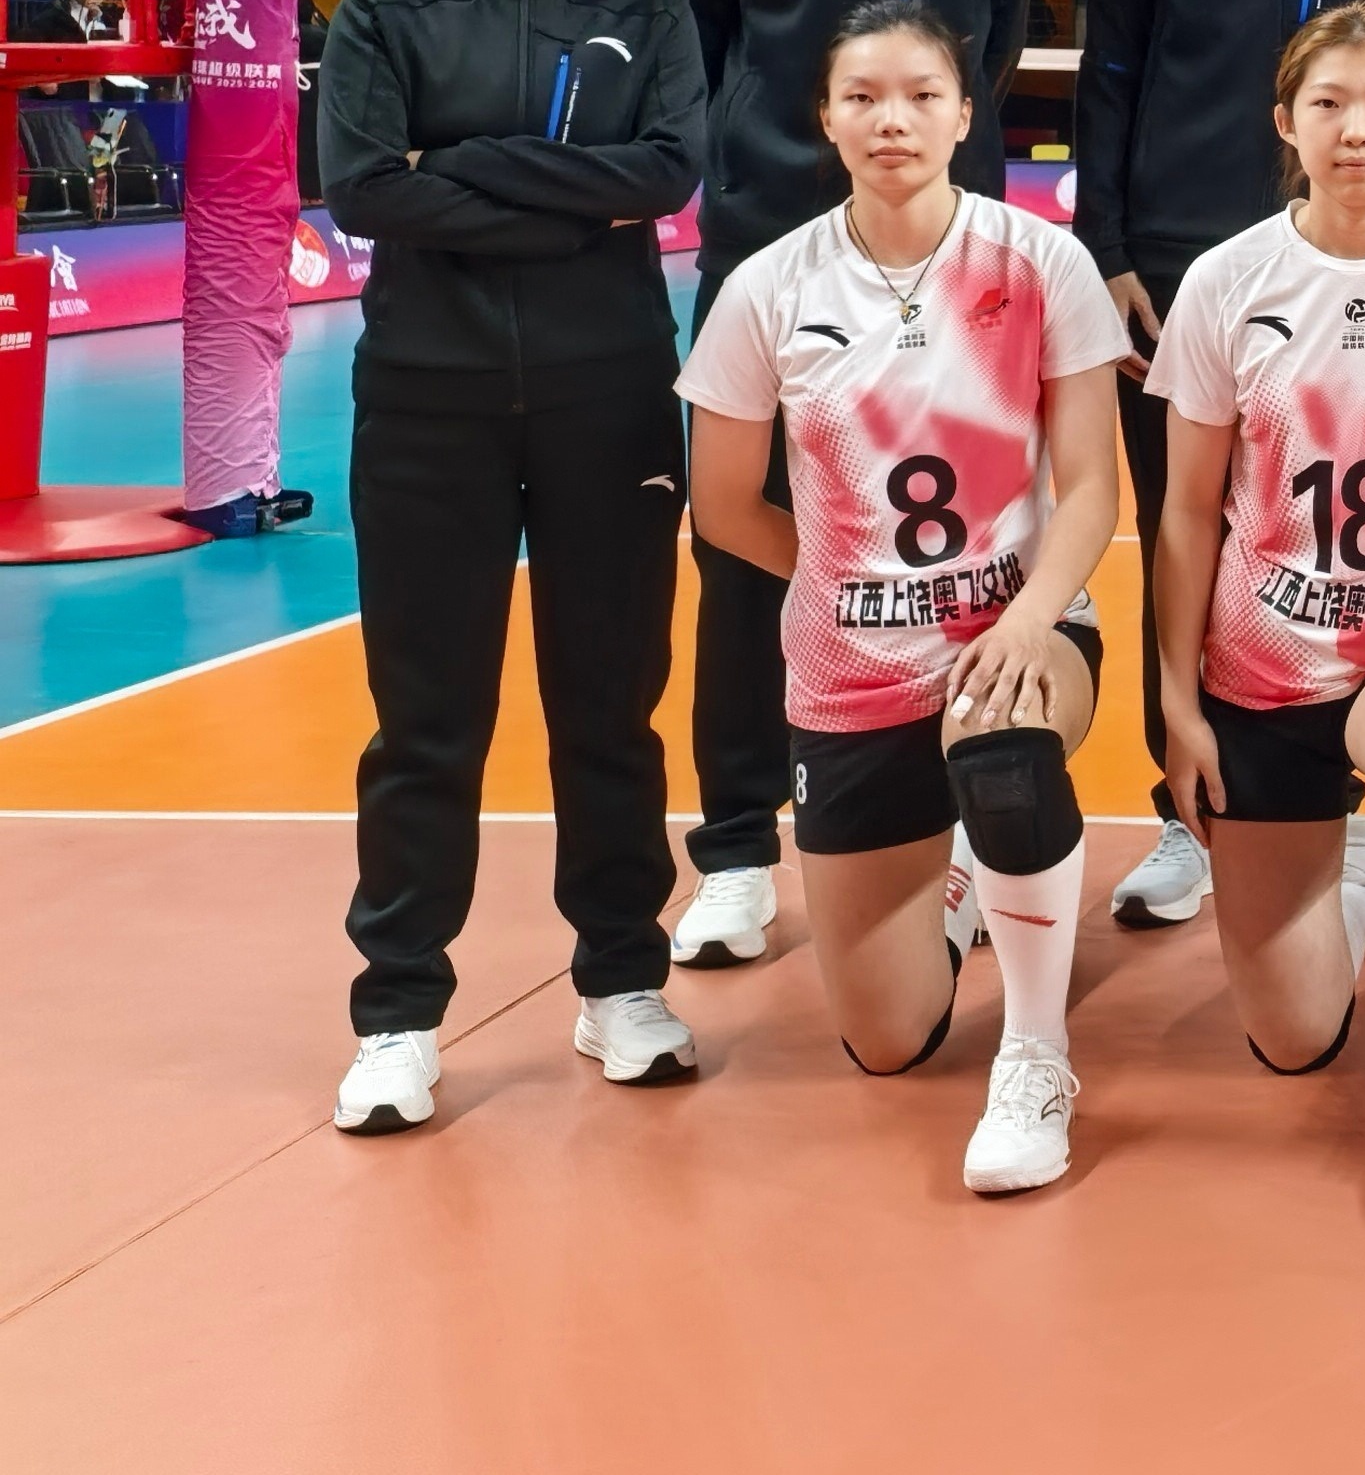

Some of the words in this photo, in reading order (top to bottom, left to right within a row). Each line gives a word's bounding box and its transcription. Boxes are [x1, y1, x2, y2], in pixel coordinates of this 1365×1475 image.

[886, 455, 968, 568] 8
[835, 552, 1027, 629] 江西上饶奥飞女排
[796, 763, 808, 805] 8
